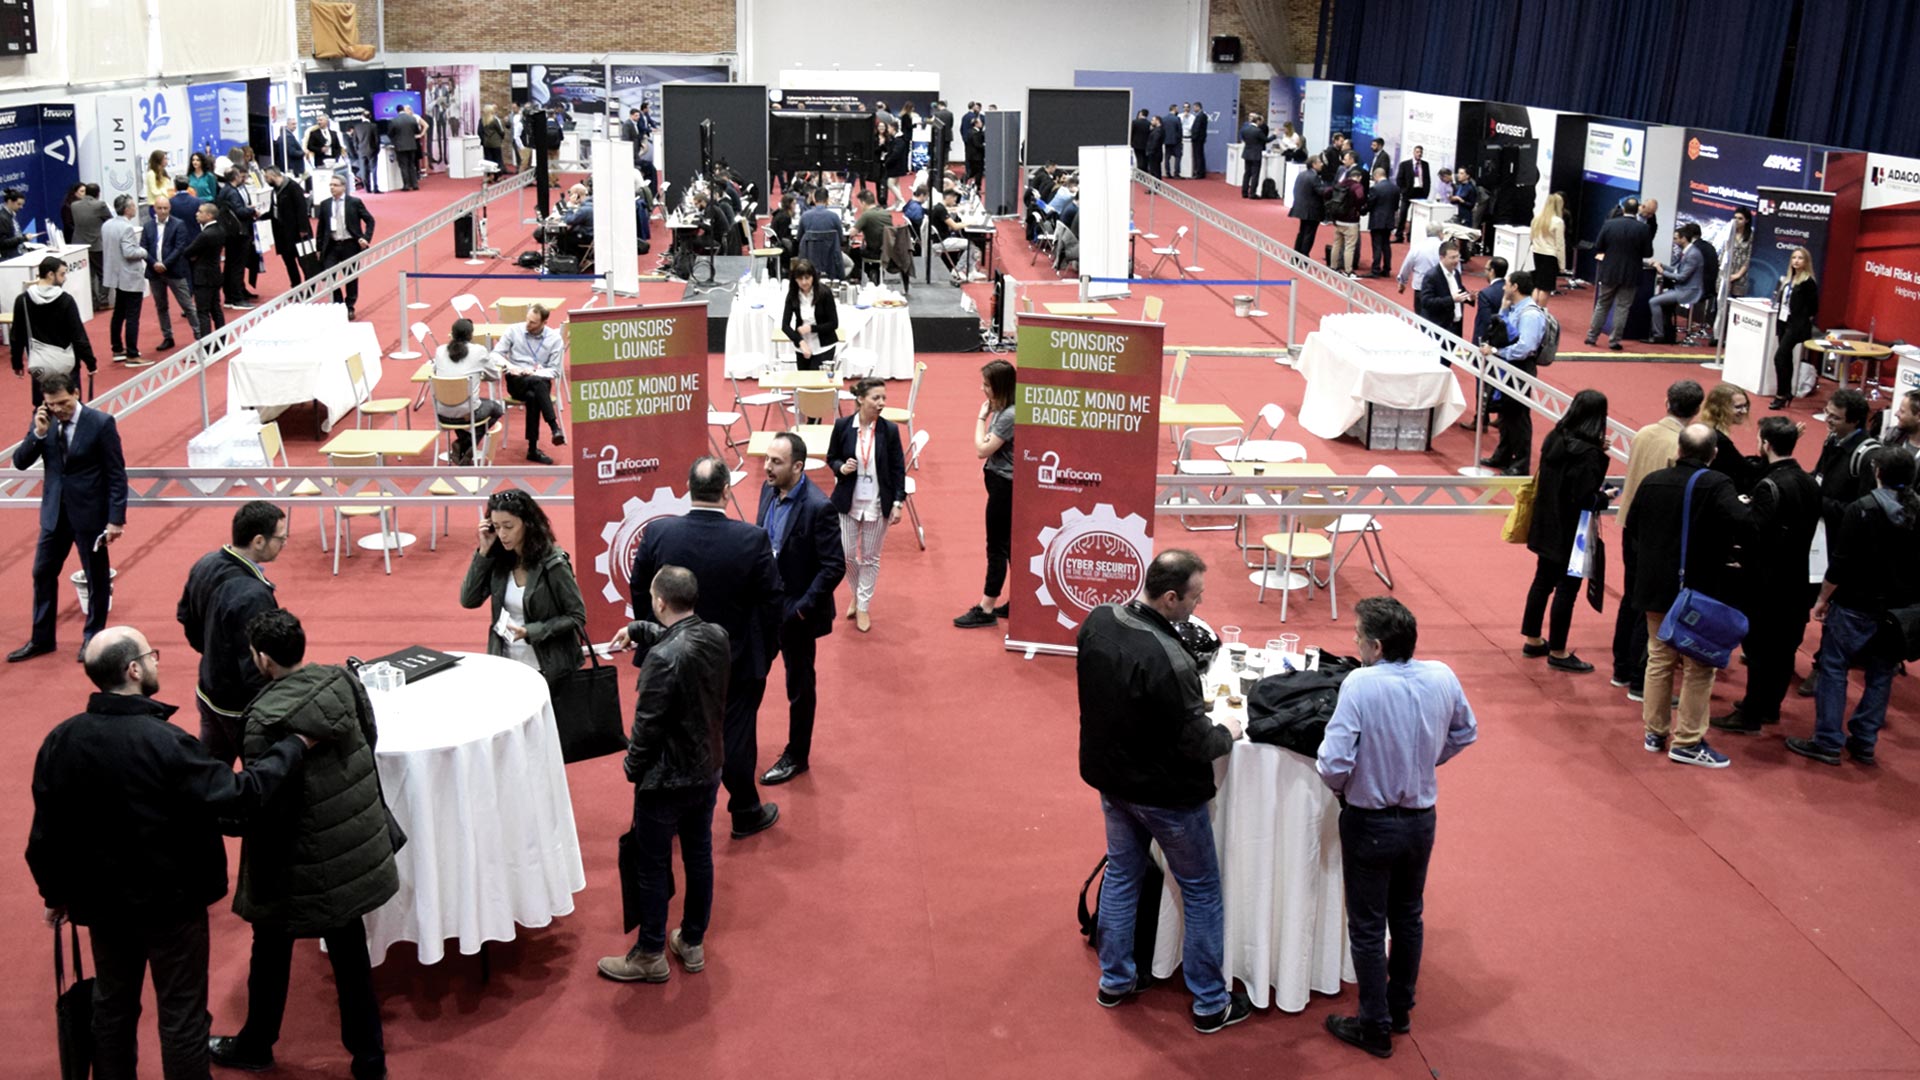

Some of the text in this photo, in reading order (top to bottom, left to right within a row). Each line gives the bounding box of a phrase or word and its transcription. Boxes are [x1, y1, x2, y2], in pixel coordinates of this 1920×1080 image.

[614, 75, 641, 84] SIMA
[1496, 122, 1528, 138] ODYSSEY
[0, 139, 36, 160] RESCOUT
[1887, 169, 1920, 183] ADACO
[1779, 201, 1831, 214] ADACOM
[1774, 227, 1810, 238] Enabling
[1866, 261, 1893, 277] Digital
[1893, 267, 1913, 282] Risk
[1742, 316, 1763, 328] ADACOM
[614, 339, 667, 360] LOUNGE
[1061, 352, 1116, 373] LOUNGE
[580, 373, 700, 401] ΕΙΣΟΔΟΣ ΜΟΝΟ ΜΕ
[589, 394, 693, 420] BADGE ΧΟΡΗΓΟΥ
[1025, 386, 1151, 413] ΕΙΣΟΔΟΣ ΜΟΝΟ ΜΕ
[1032, 407, 1142, 432] BADGE ΧΟΡΗΓΟΥ
[616, 458, 660, 470] infocom
[1056, 468, 1102, 481] infocom
[1066, 558, 1137, 574] CYBER SECURITY
[1073, 568, 1081, 576] THE
[1083, 569, 1092, 577] AGE
[1102, 571, 1127, 580] INDUSTRY
[1680, 635, 1721, 659] Diesel
